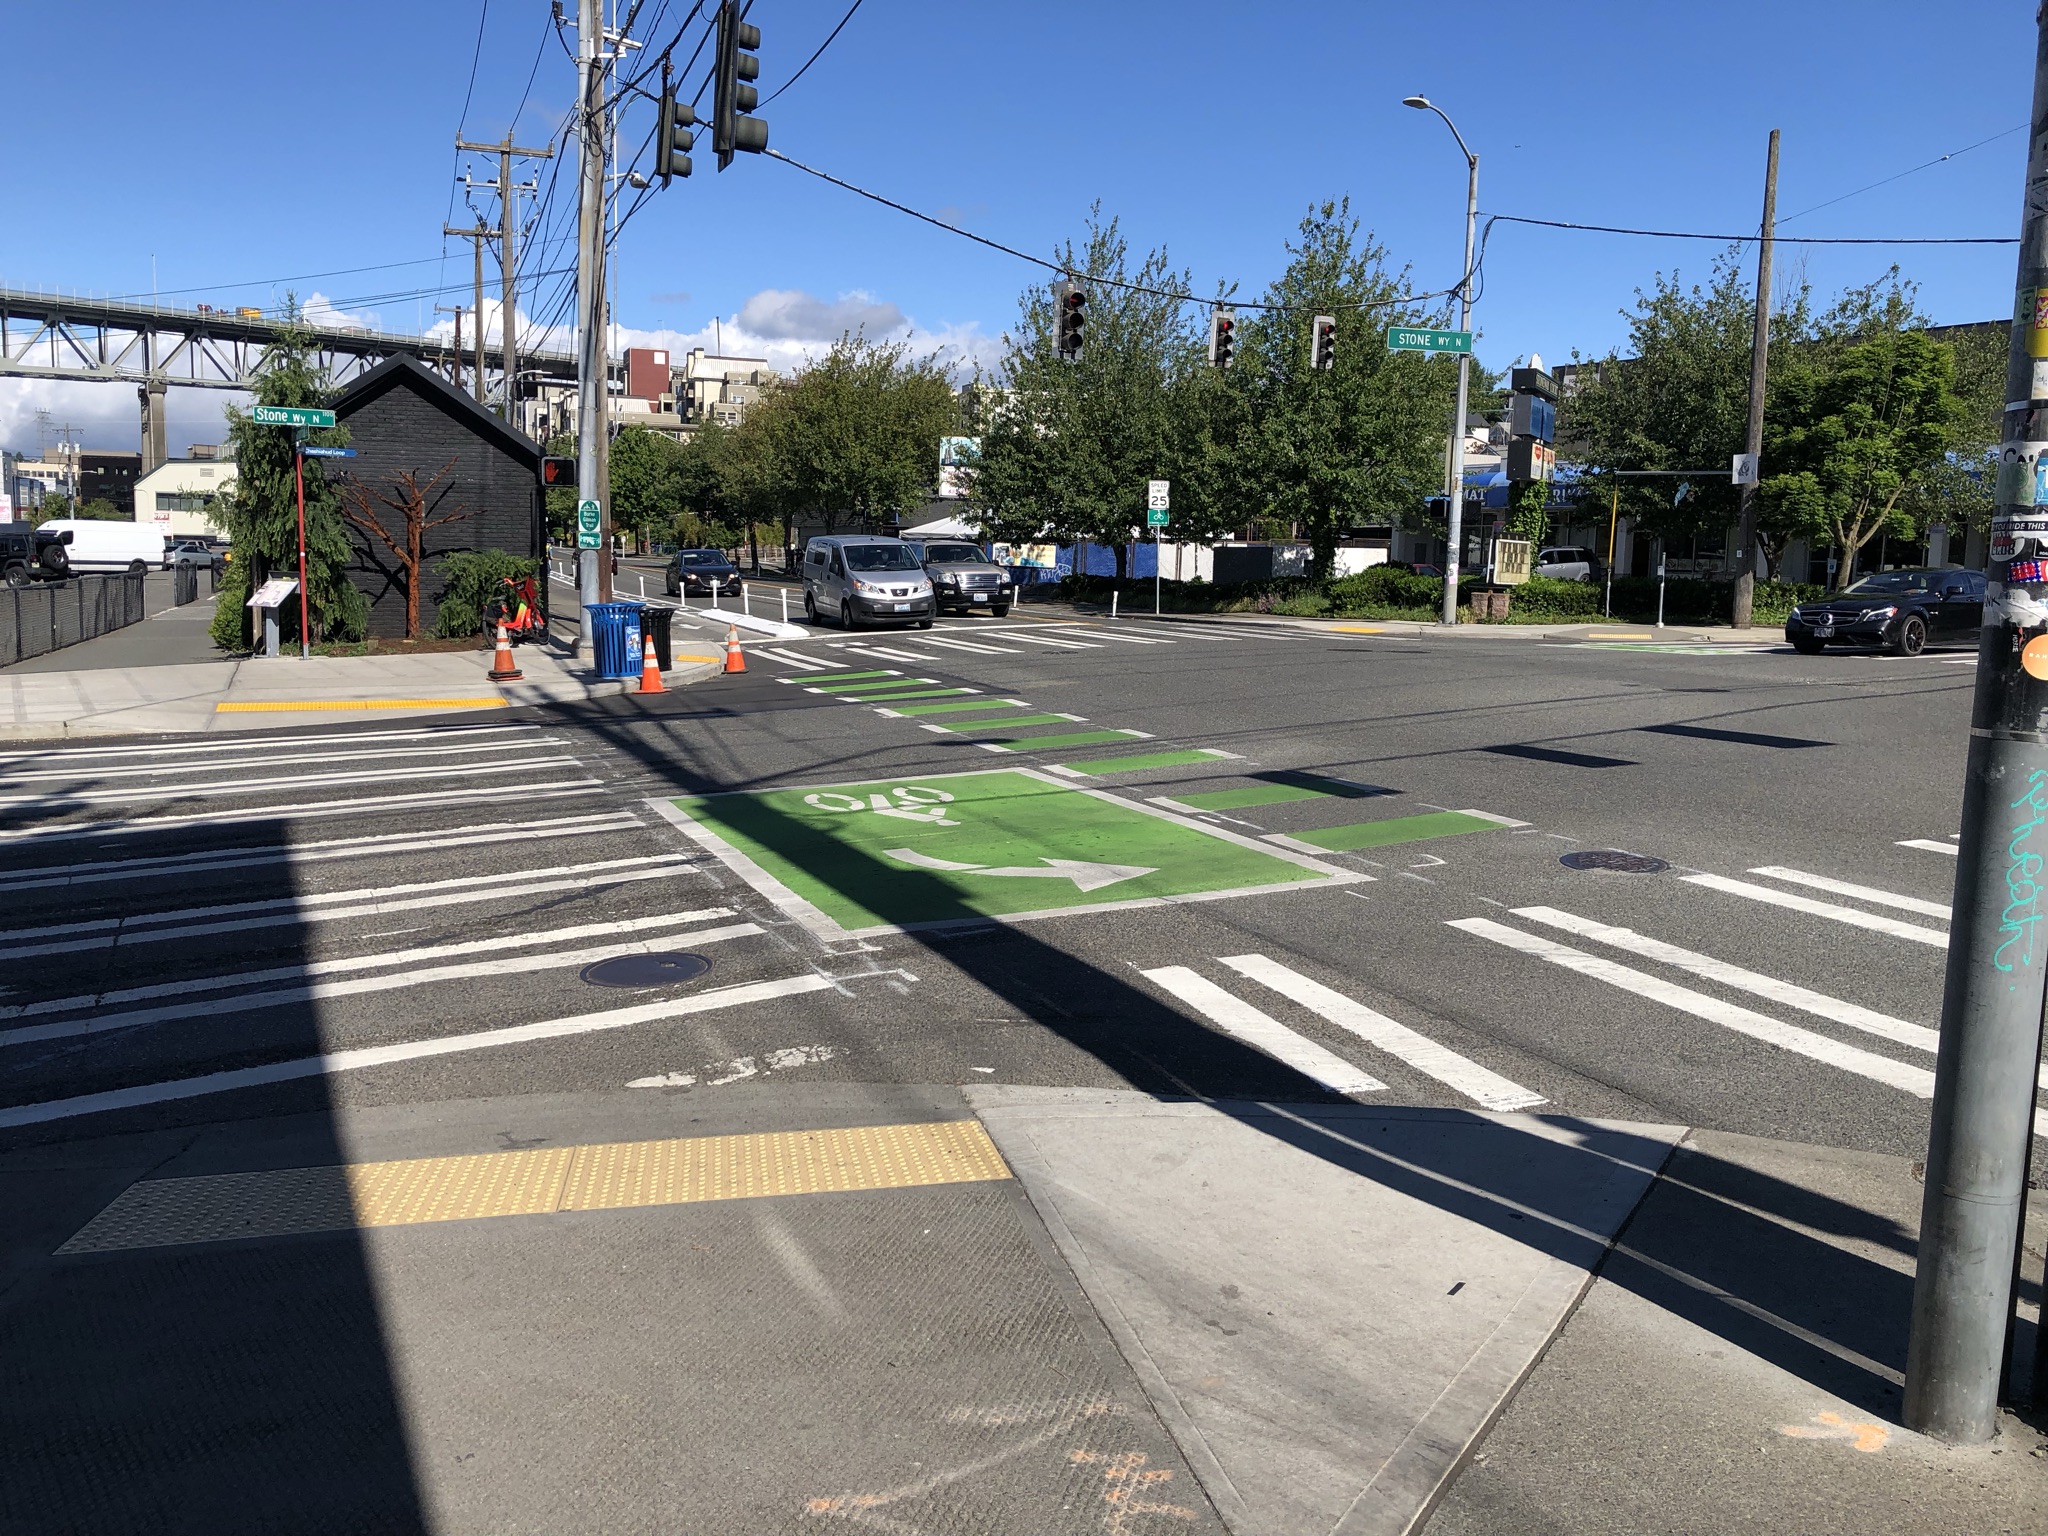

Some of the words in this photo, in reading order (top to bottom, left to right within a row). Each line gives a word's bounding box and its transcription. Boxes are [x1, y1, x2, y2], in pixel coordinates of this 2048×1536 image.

[1398, 333, 1431, 346] STONE
[1438, 336, 1450, 346] WY
[1455, 337, 1462, 347] N
[256, 407, 288, 422] Stone
[292, 413, 306, 425] Wy
[312, 414, 320, 424] N
[1151, 495, 1167, 506] 25
[2027, 522, 2046, 530] THIS
